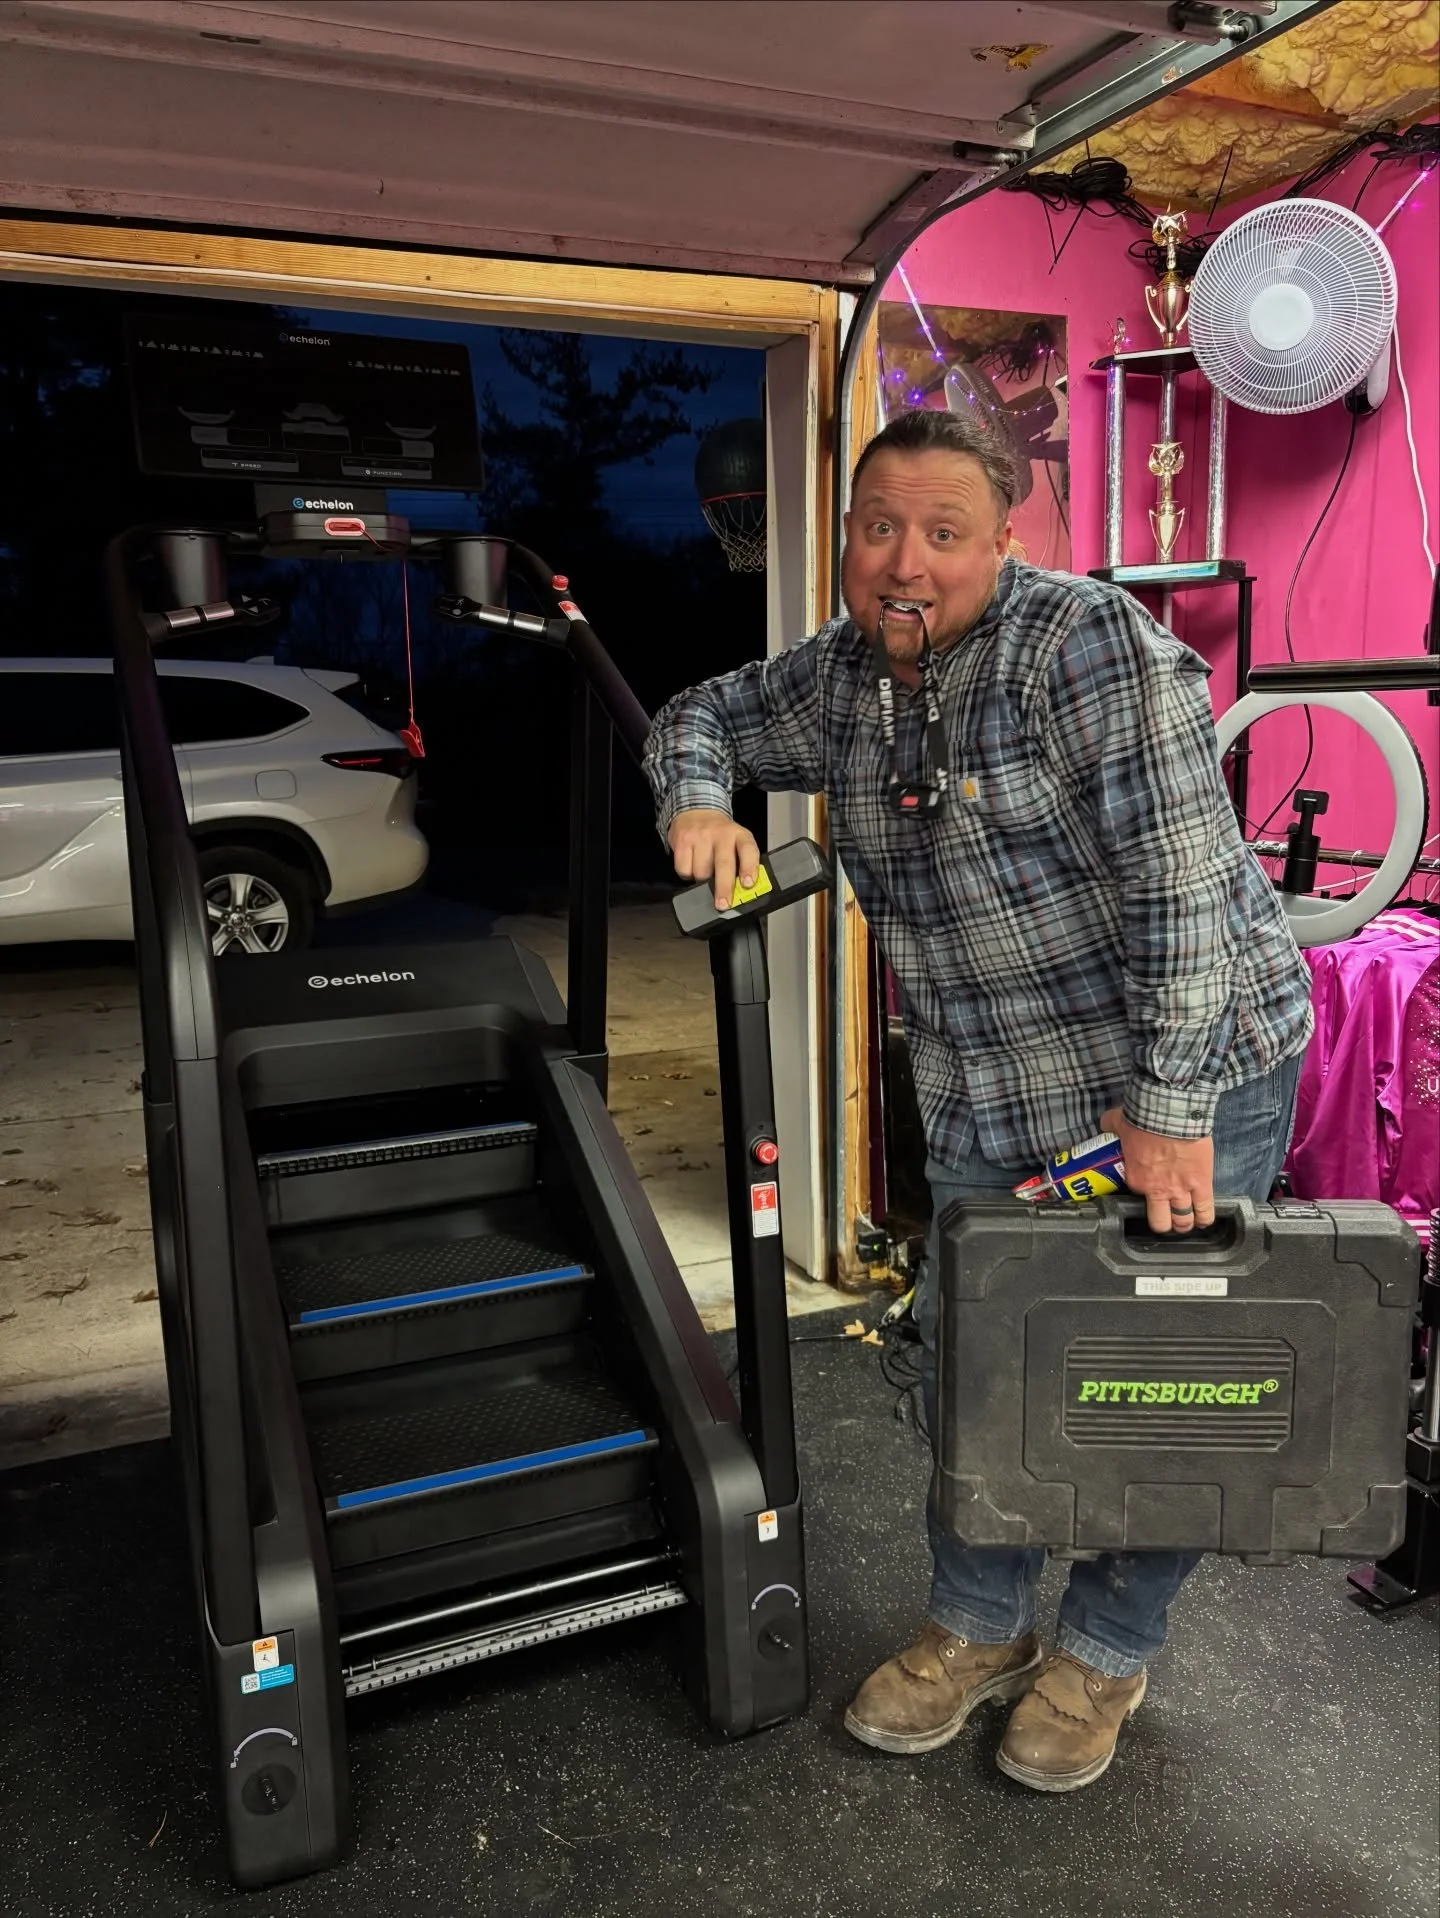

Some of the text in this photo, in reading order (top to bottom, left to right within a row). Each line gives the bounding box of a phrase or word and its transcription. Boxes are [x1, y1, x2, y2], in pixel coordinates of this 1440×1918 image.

[289, 336, 330, 346] echelon
[305, 499, 354, 511] echelon
[330, 971, 415, 986] echelon
[1205, 1283, 1222, 1292] UP
